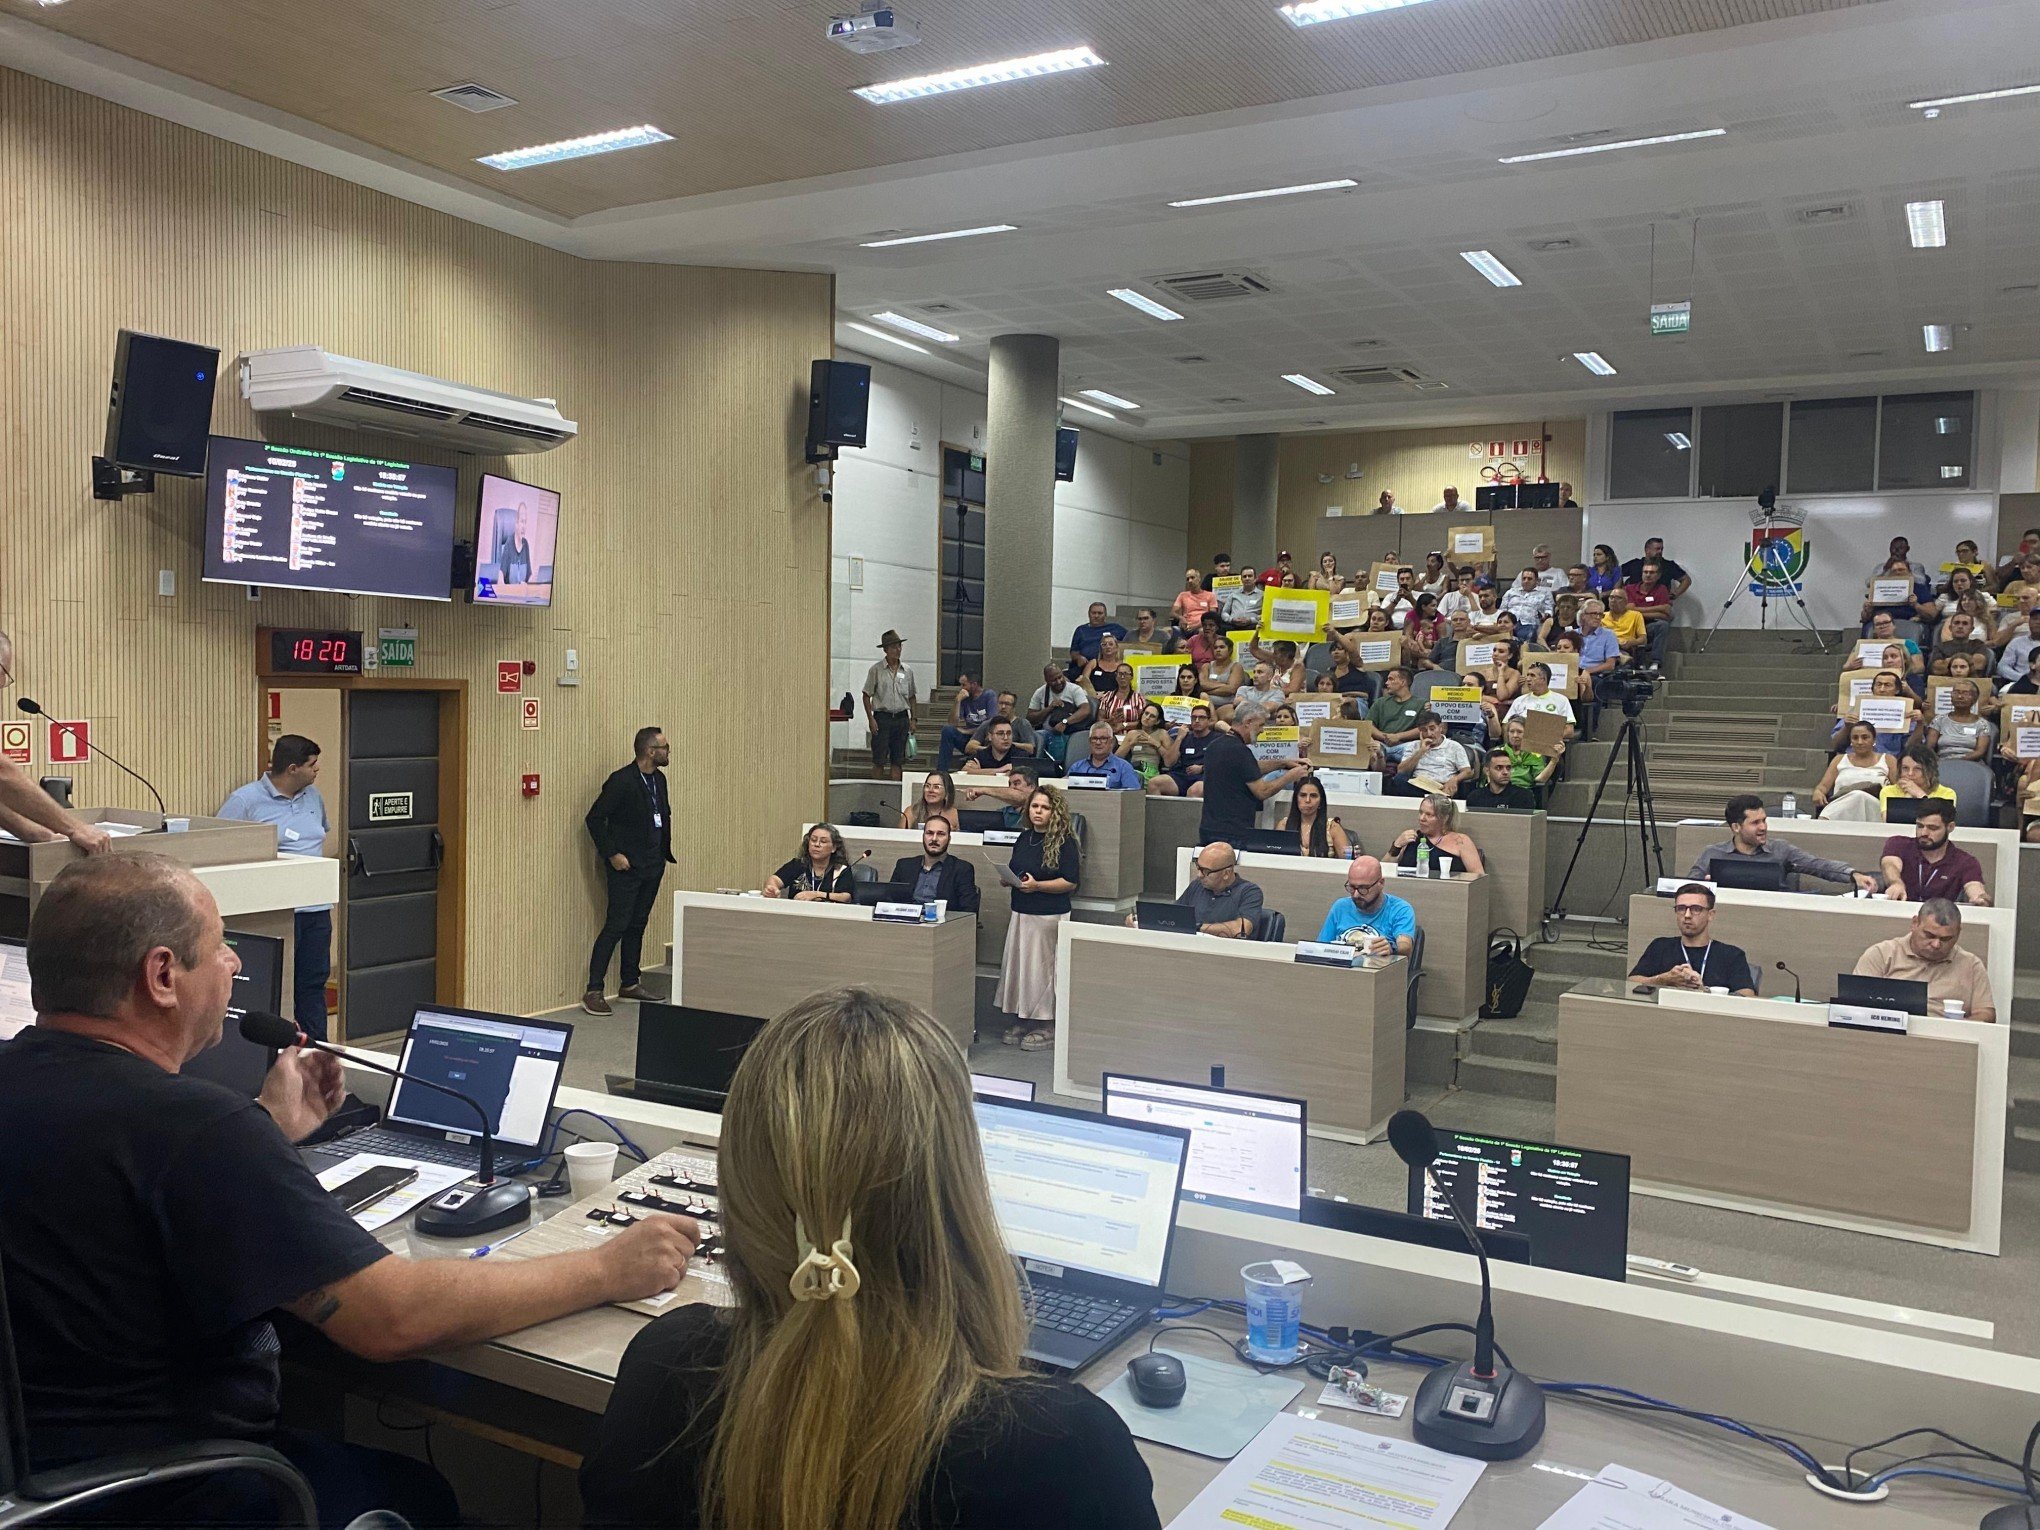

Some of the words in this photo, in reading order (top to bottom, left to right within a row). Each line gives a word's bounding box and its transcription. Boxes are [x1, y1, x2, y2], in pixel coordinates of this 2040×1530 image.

[382, 640, 414, 660] SAÍDA
[404, 797, 408, 805] E
[384, 806, 408, 814] EMPURRE
